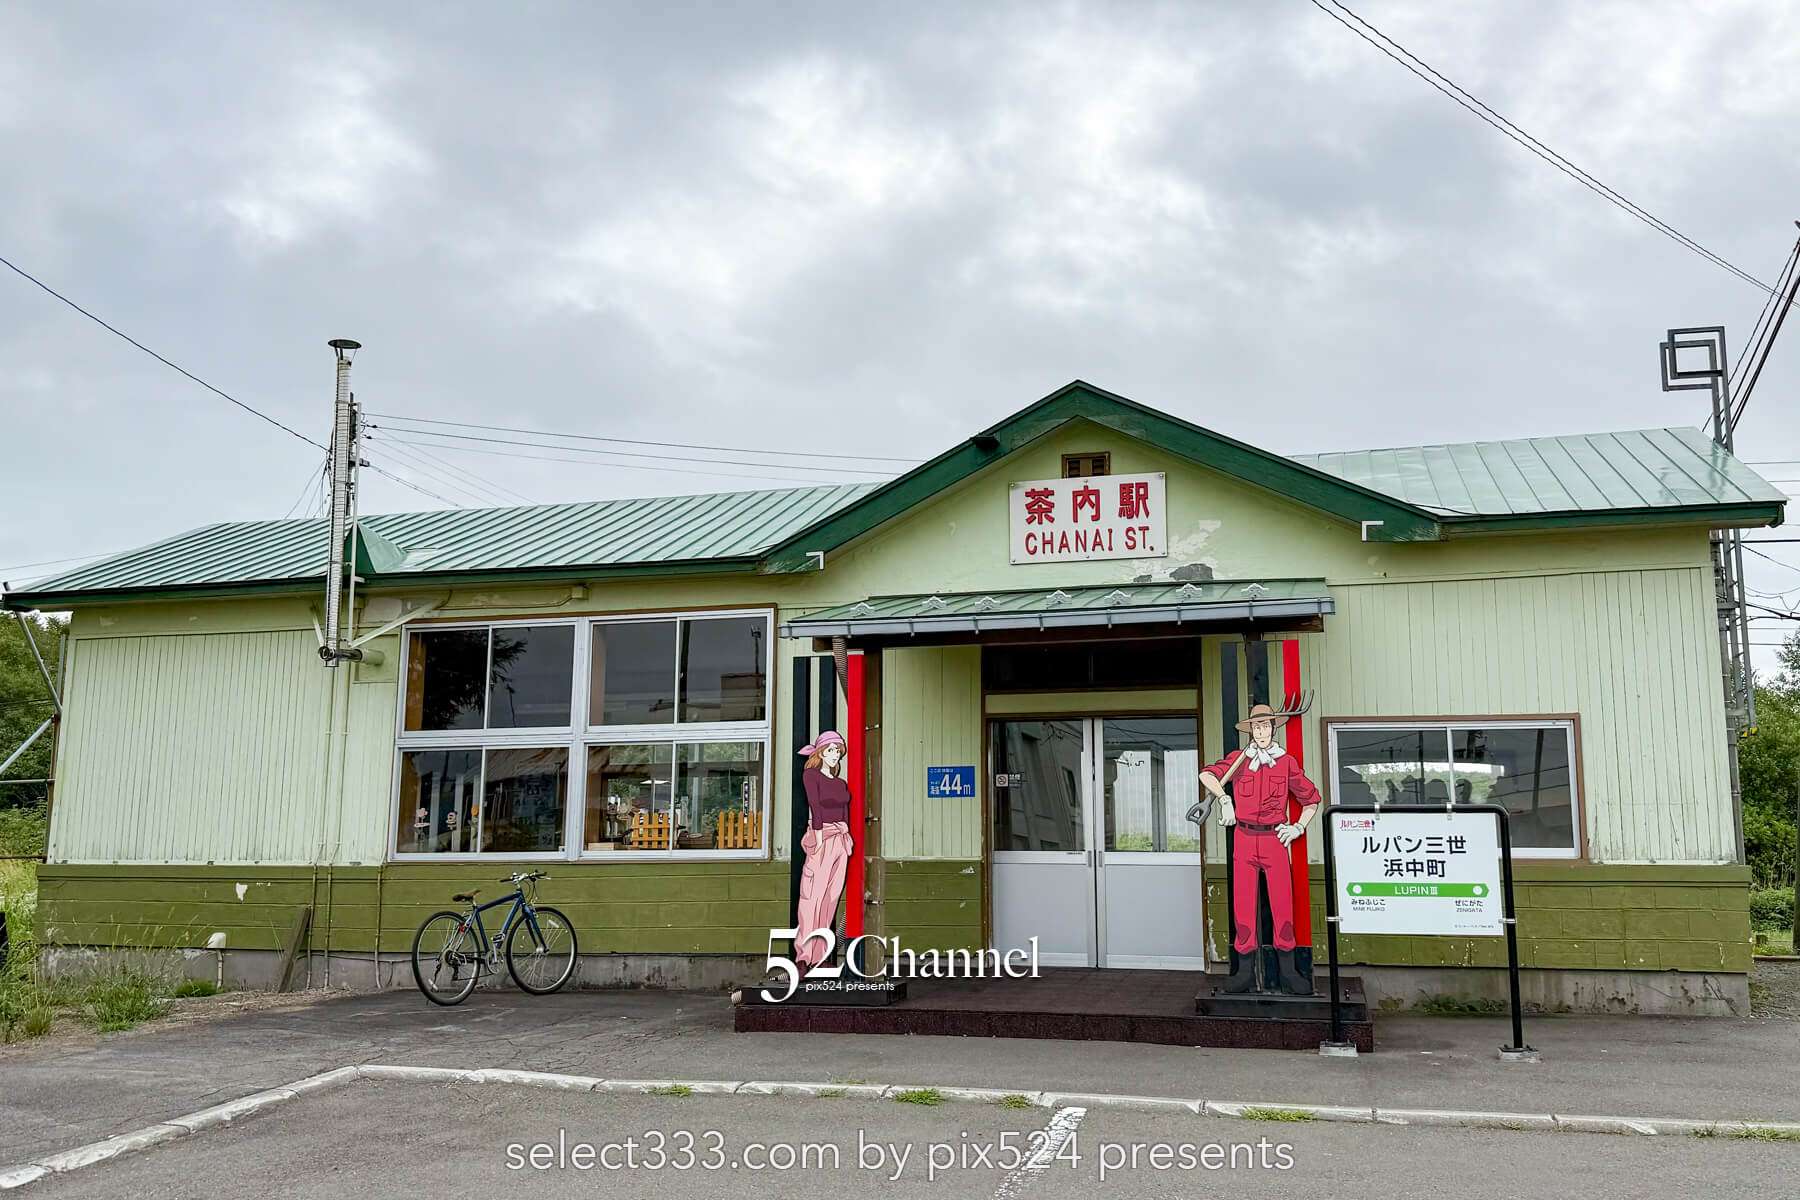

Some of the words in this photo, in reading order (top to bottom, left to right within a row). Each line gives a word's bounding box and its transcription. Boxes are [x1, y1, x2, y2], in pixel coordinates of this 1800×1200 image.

[1024, 481, 1150, 525] 茶内駅
[1024, 528, 1114, 556] CHANAI
[1124, 526, 1155, 552] ST.
[1362, 835, 1467, 855] ルパン三世
[1384, 858, 1447, 878] 浜中町
[1351, 898, 1386, 906] みねふじこ
